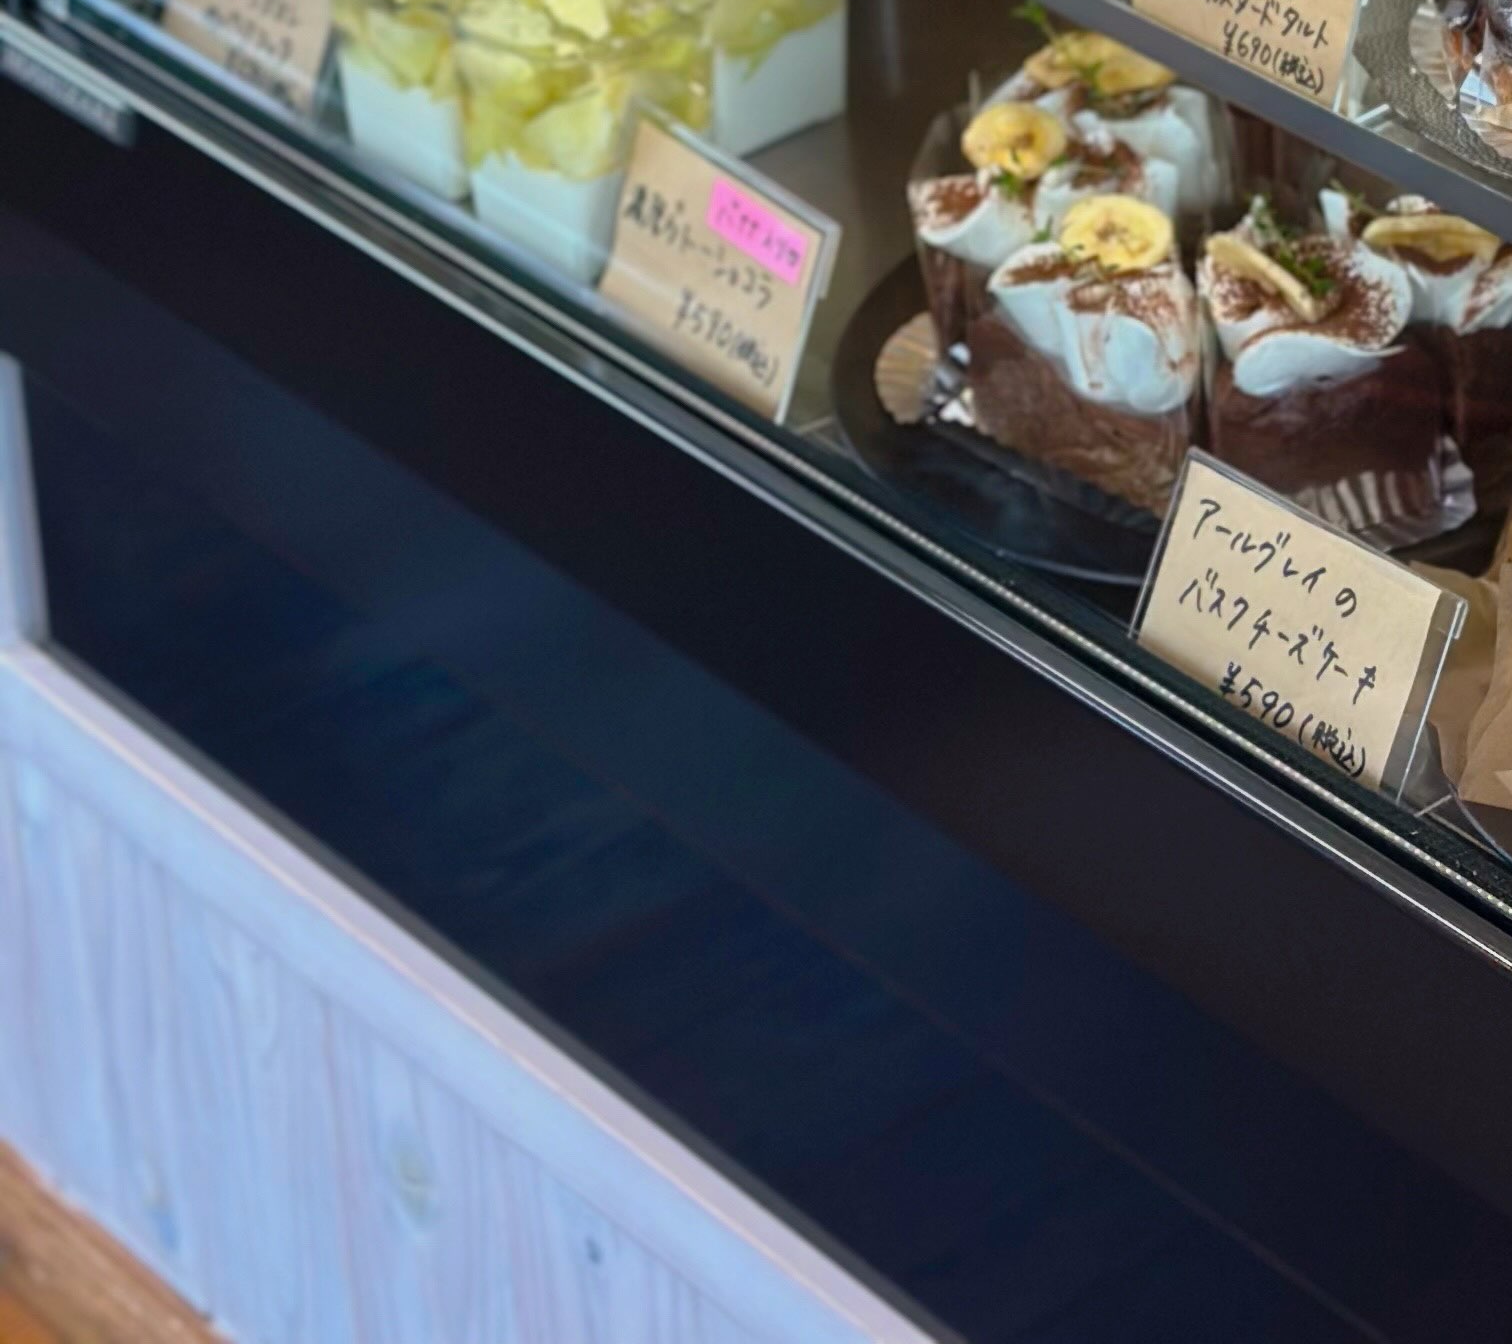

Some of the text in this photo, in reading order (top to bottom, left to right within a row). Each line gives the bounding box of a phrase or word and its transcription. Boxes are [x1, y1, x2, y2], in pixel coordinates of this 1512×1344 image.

[1192, 498, 1358, 618] アールグレイの
[1178, 568, 1378, 705] バスクチーズケーキ
